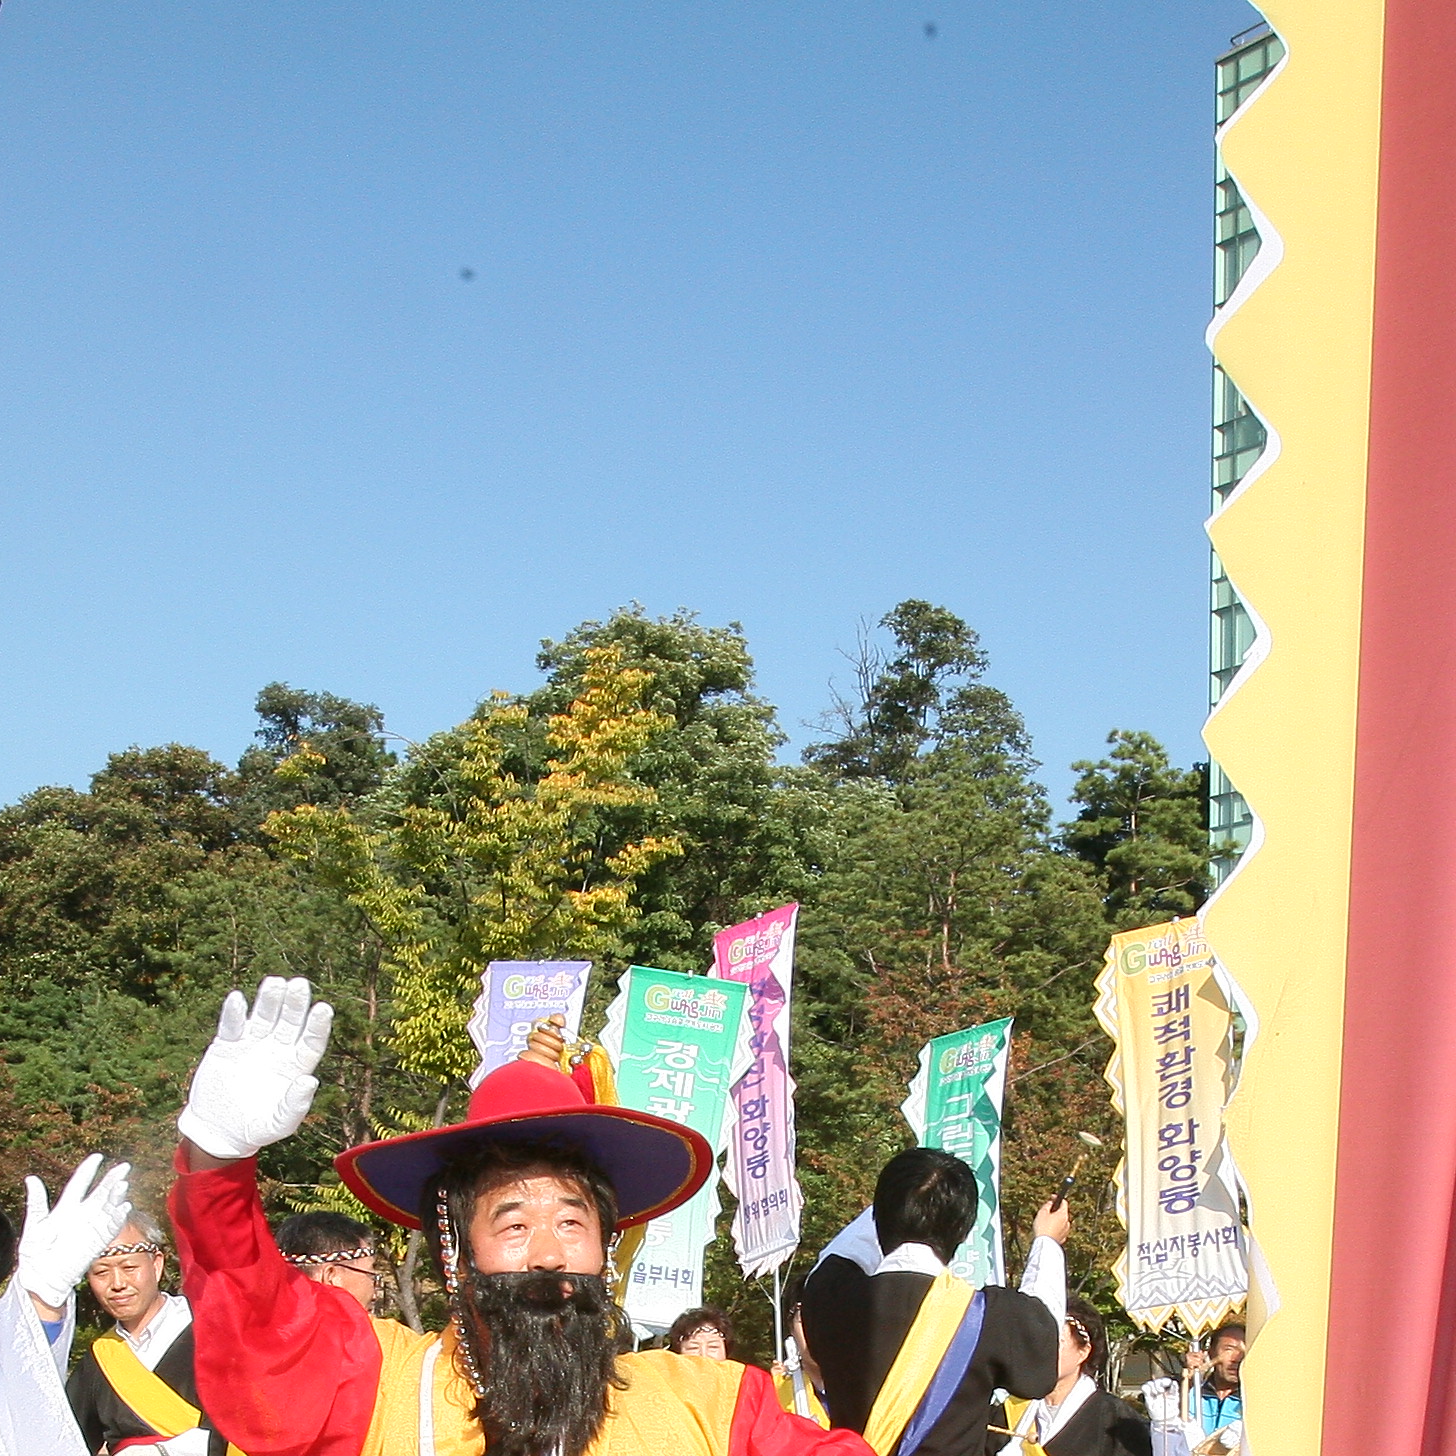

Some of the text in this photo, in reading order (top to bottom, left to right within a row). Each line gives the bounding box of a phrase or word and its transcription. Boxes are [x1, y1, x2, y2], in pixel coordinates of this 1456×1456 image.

[1150, 982, 1197, 1109] 쾌적환경
[741, 1093, 772, 1180] 화양동
[1157, 1117, 1203, 1215] 화양동
[1136, 1225, 1240, 1267] 적십자봉사회
